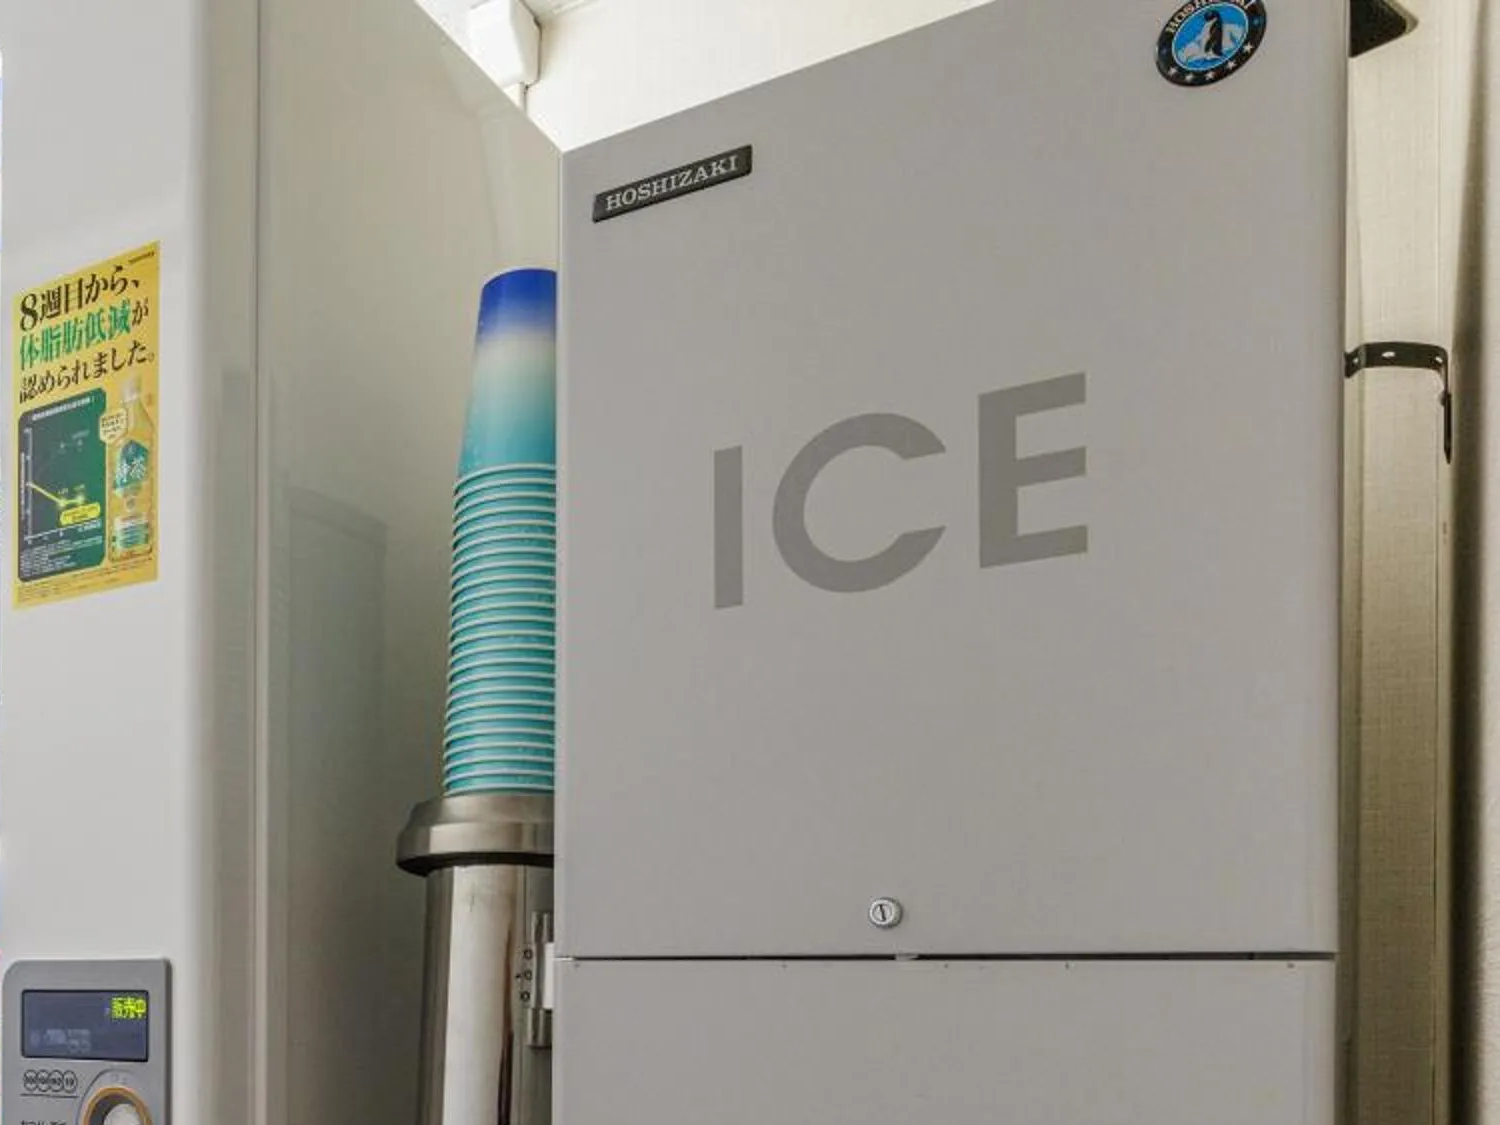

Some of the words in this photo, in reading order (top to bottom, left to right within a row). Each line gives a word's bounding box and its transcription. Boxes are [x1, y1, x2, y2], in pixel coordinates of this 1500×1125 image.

[606, 155, 739, 212] HOSHIZAKI
[20, 297, 149, 371] 体脂肪低減が
[714, 372, 1088, 609] ICE
